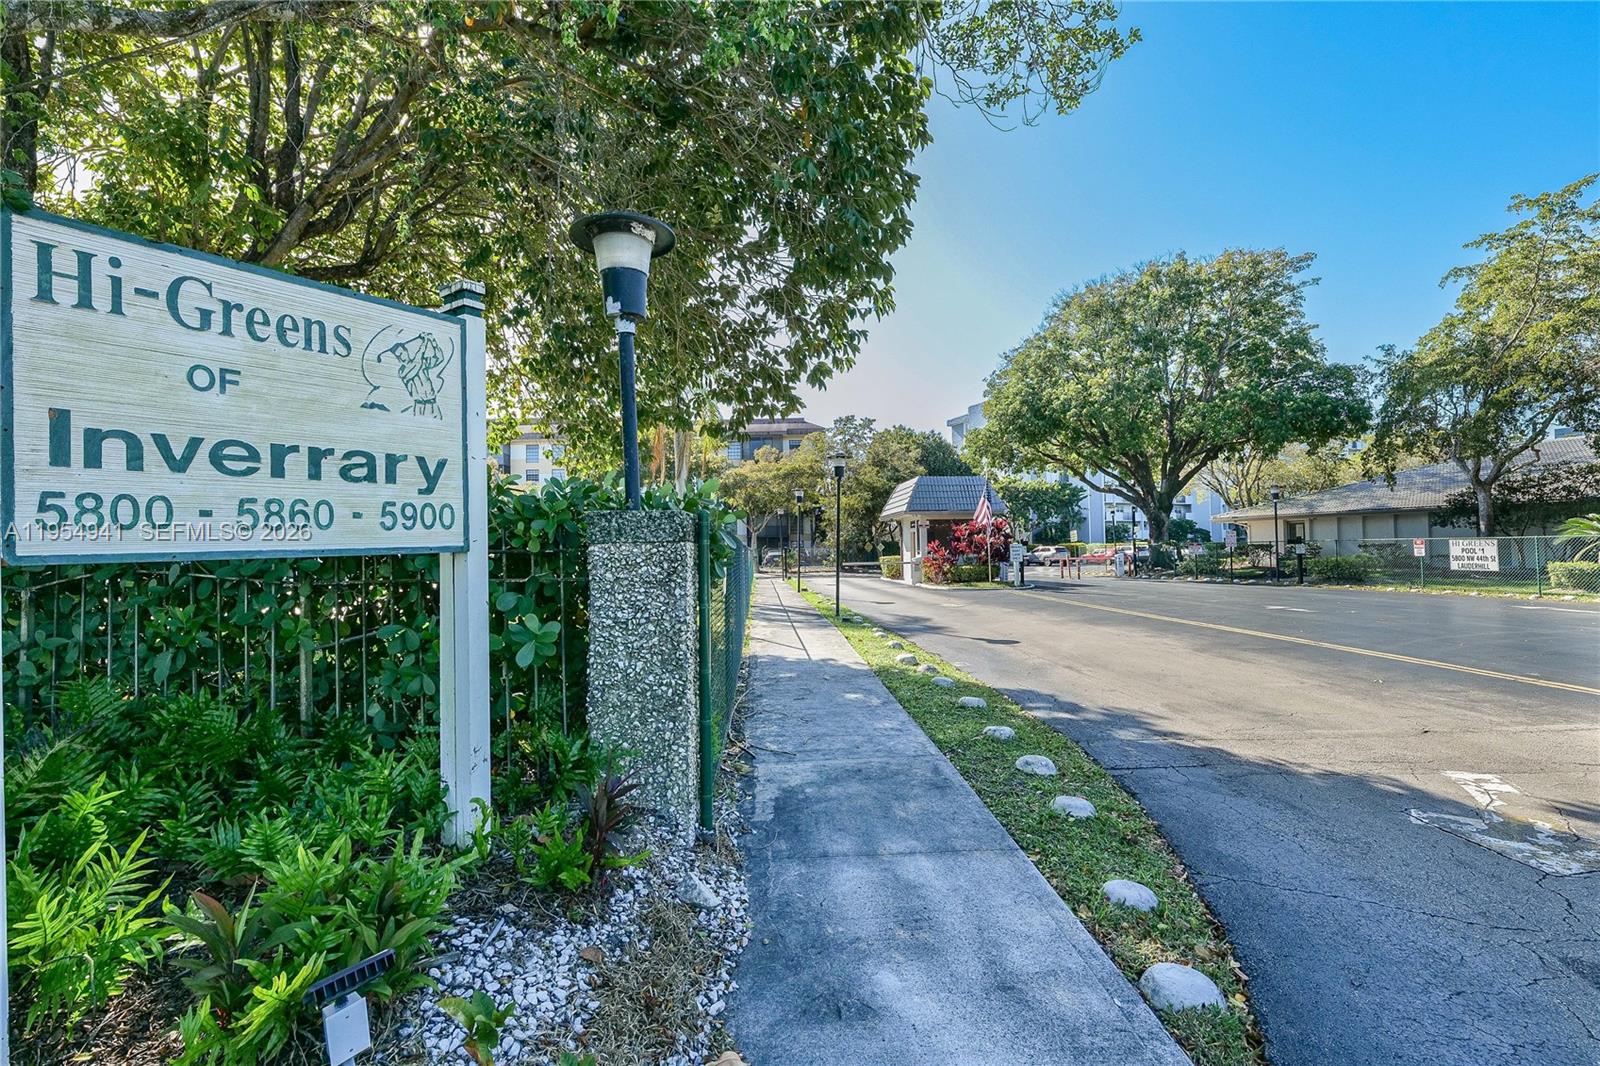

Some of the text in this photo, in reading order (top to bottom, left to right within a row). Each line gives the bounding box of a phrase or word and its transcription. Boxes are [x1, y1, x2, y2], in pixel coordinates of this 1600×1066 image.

[30, 239, 353, 358] Hi-Greens
[185, 364, 242, 395] OF
[48, 407, 449, 496] Inverrary
[35, 490, 174, 531] 5800
[235, 497, 335, 531] 5860
[380, 500, 456, 531] 5900
